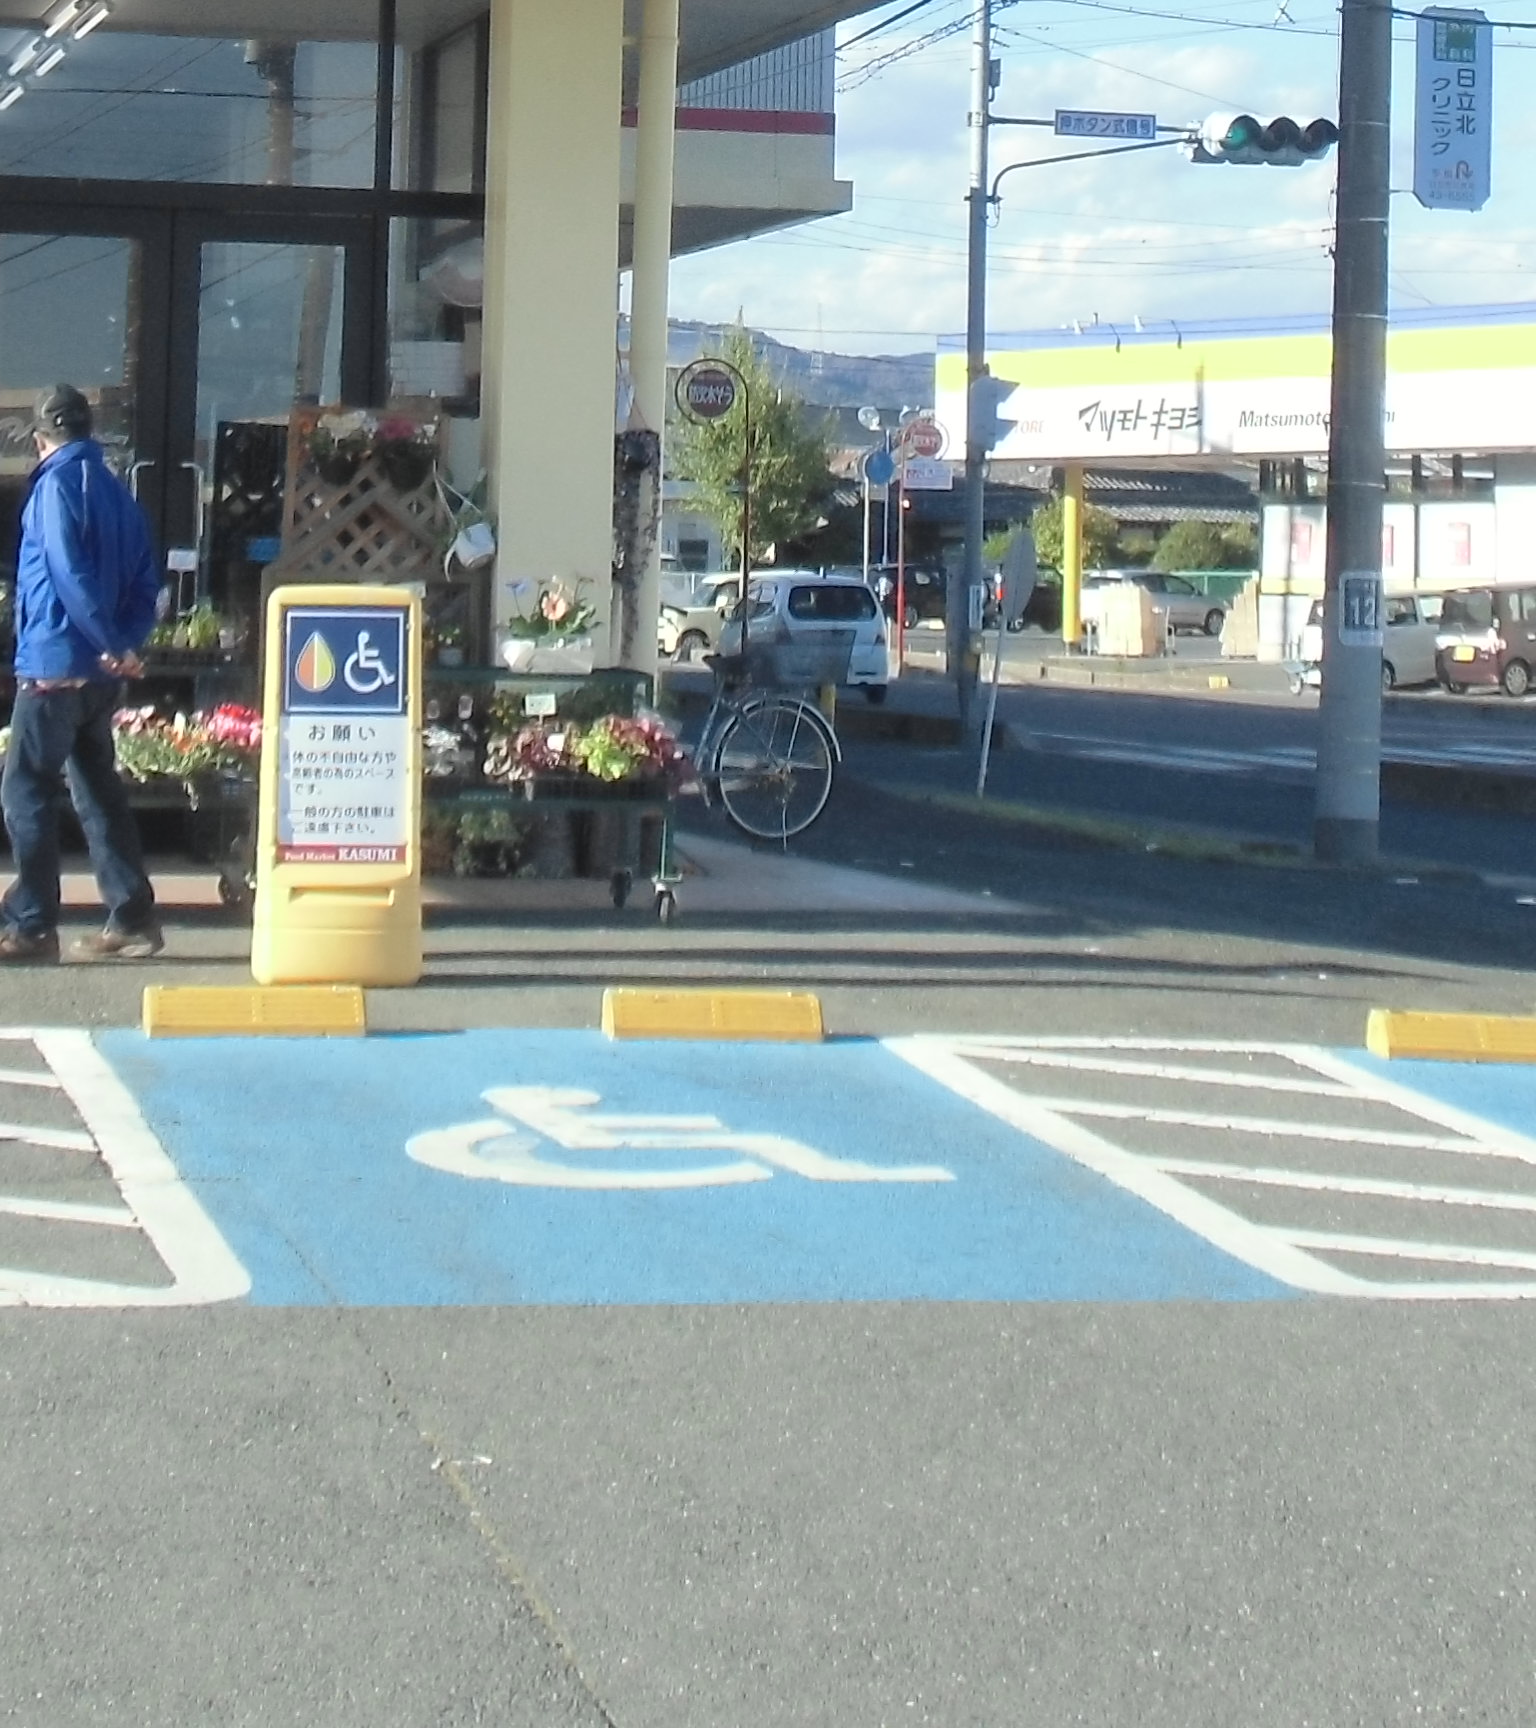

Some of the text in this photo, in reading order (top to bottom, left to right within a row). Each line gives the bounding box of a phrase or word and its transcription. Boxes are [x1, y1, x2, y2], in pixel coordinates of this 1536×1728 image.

[1431, 77, 1451, 156] クリニック
[1456, 68, 1476, 135] 日立北
[308, 724, 376, 741] お願い
[338, 847, 398, 861] KASUMI
